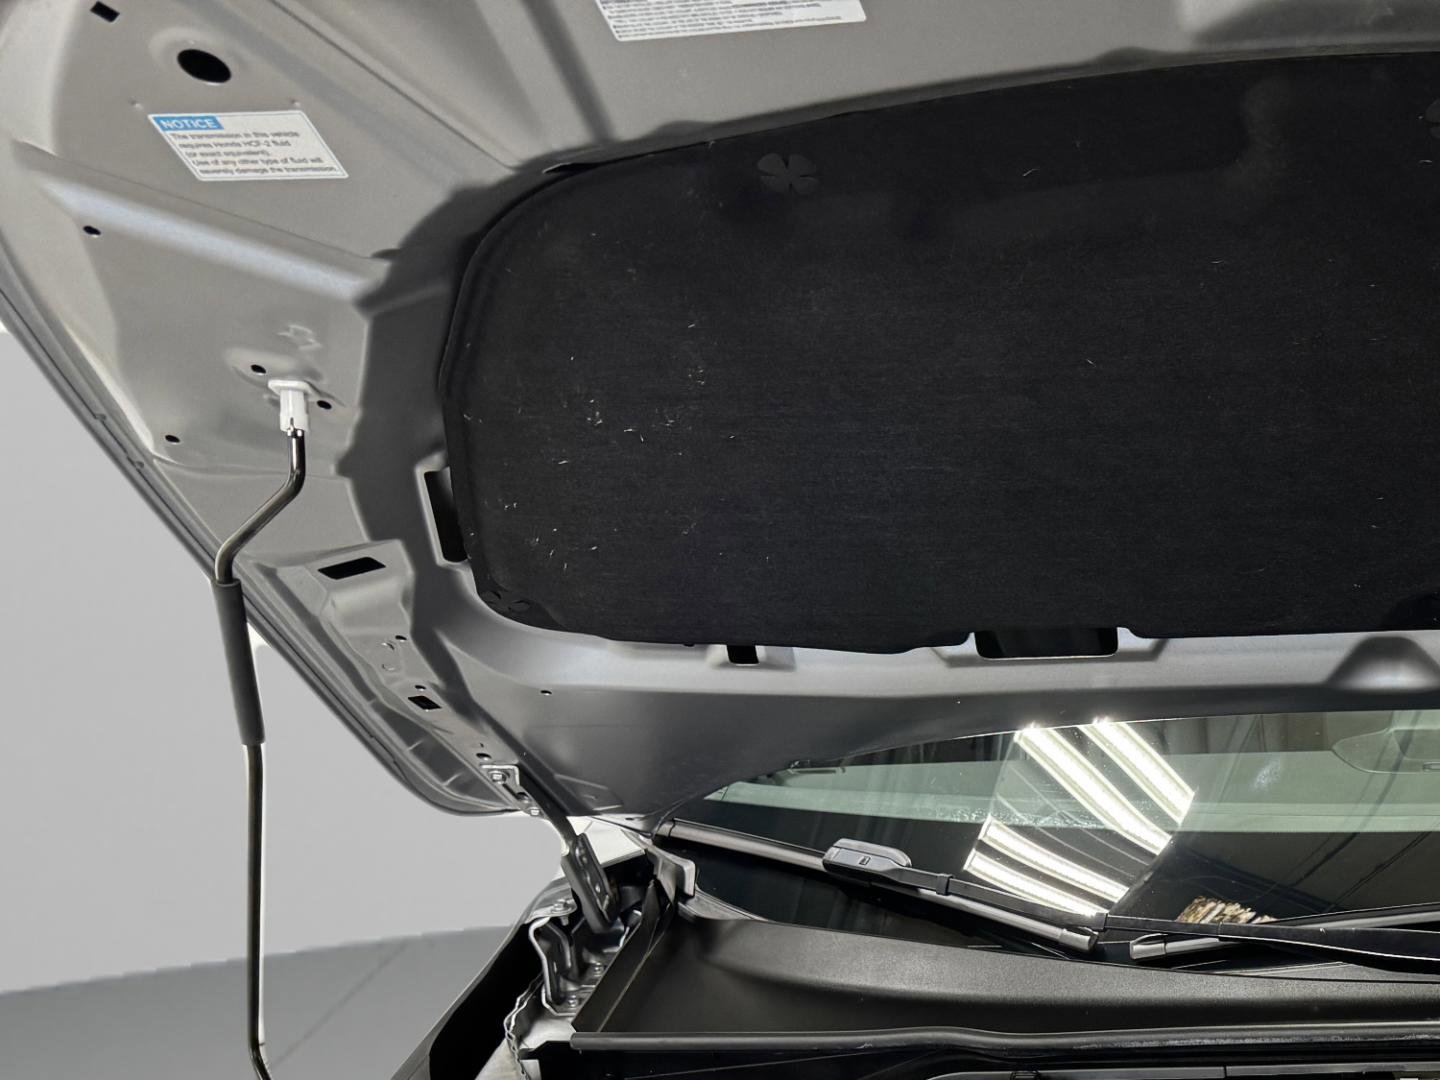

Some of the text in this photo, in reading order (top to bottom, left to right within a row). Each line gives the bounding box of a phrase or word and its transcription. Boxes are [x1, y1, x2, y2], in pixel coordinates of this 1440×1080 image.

[161, 118, 218, 129] NOTICE
[170, 132, 188, 140] The
[192, 132, 242, 140] transmission
[222, 159, 237, 167] any
[260, 158, 279, 166] type
[199, 168, 234, 176] severely
[235, 167, 269, 175] damage
